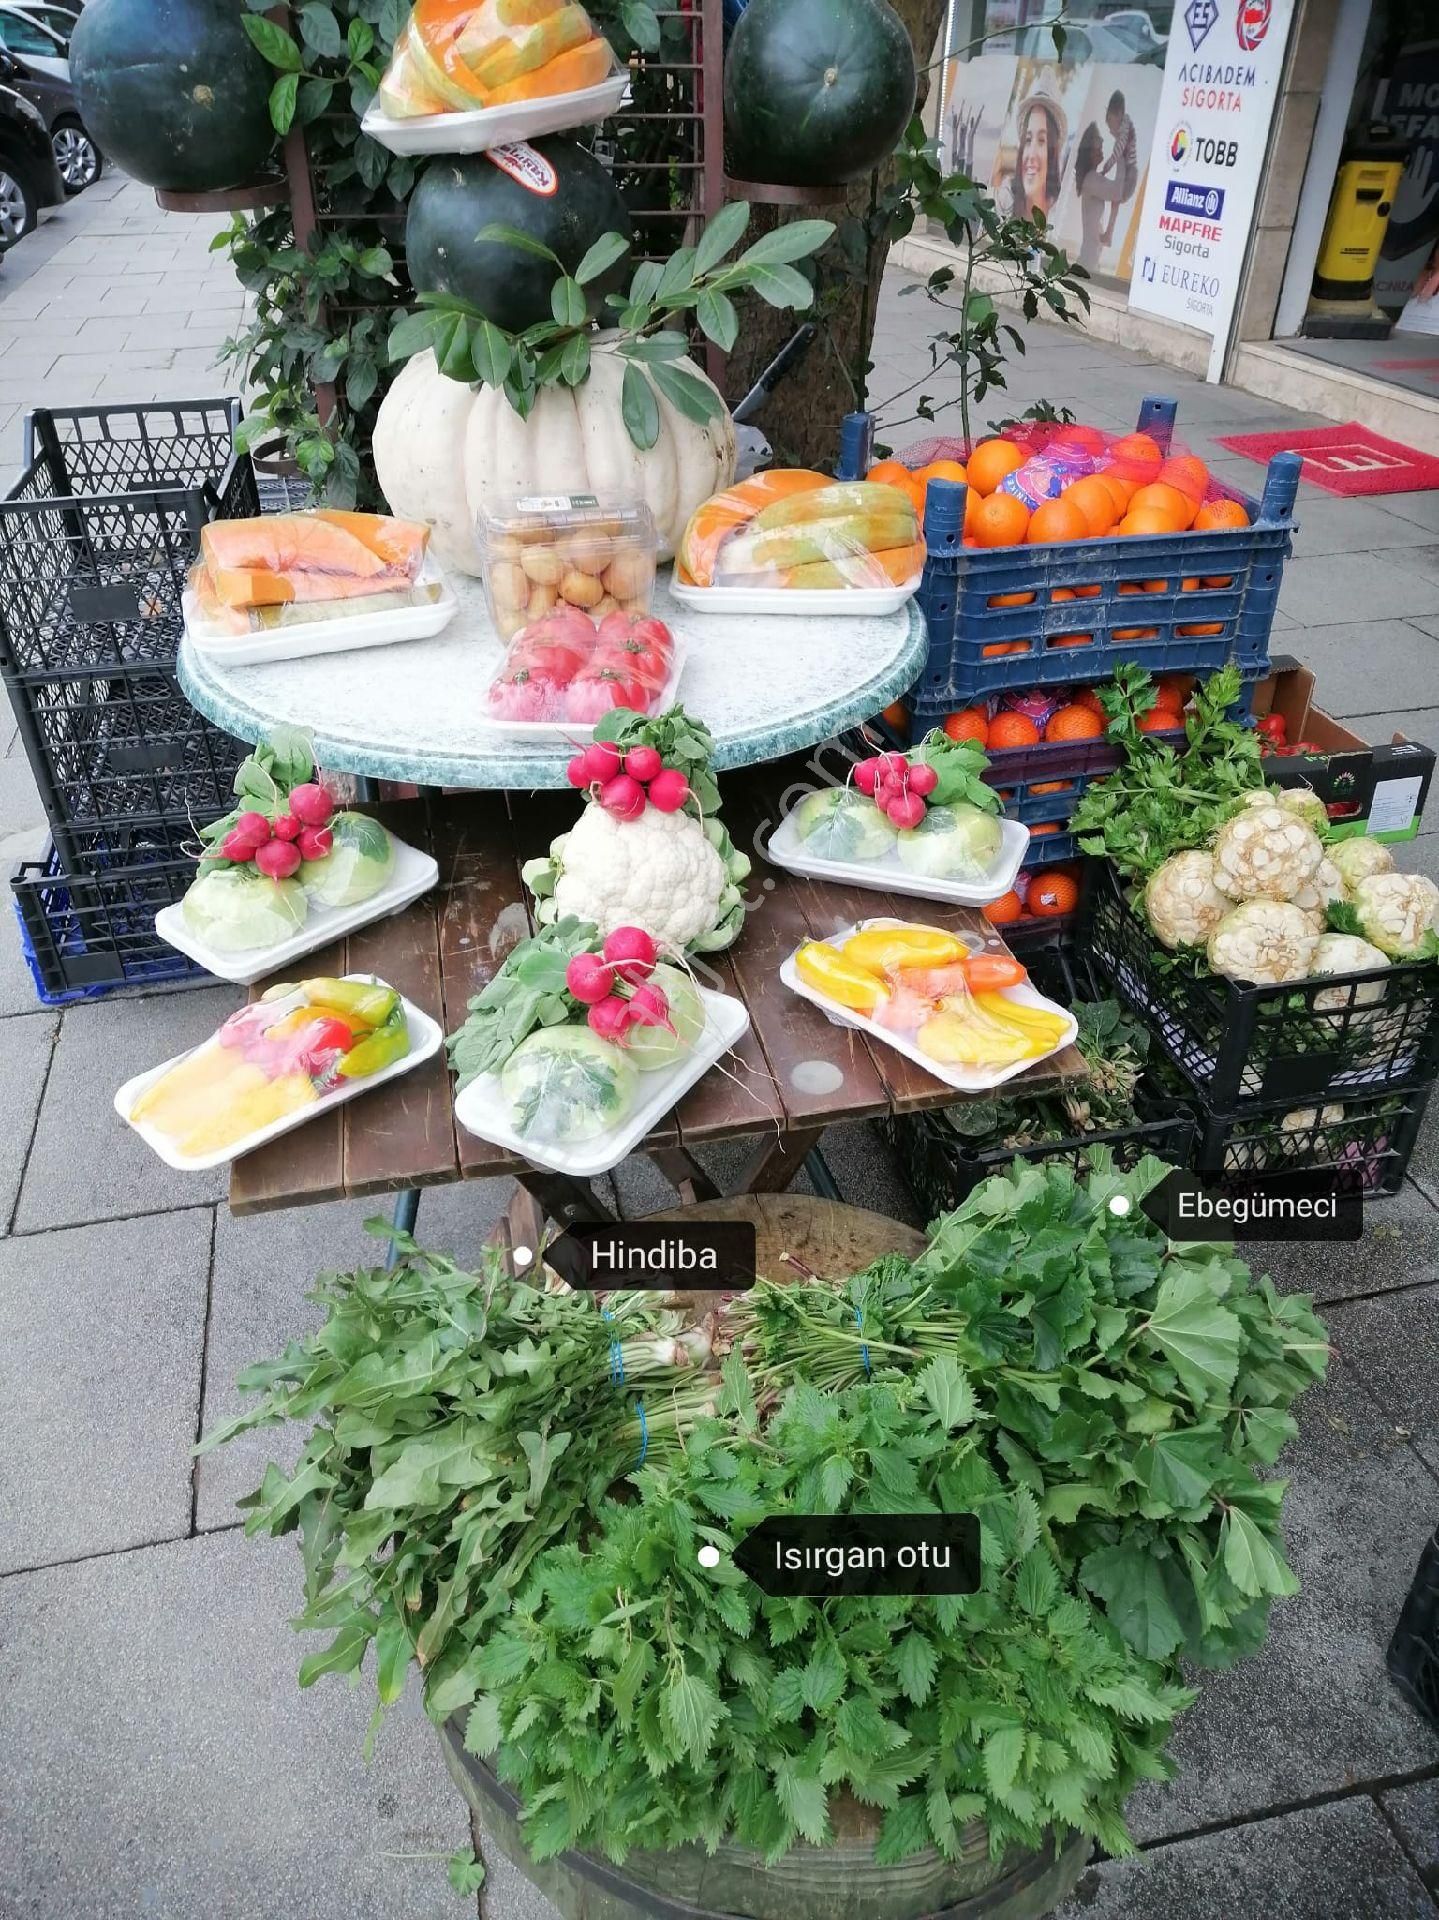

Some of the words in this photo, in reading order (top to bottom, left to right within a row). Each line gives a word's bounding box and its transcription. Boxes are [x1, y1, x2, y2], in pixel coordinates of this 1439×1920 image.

[1178, 62, 1256, 87] ACIBADEM
[1195, 136, 1239, 168] TOBB
[1171, 186, 1206, 209] Allianz
[1159, 215, 1223, 243] MAPFRE
[1164, 234, 1210, 259] Sigorta
[1162, 264, 1220, 298] EUREKO
